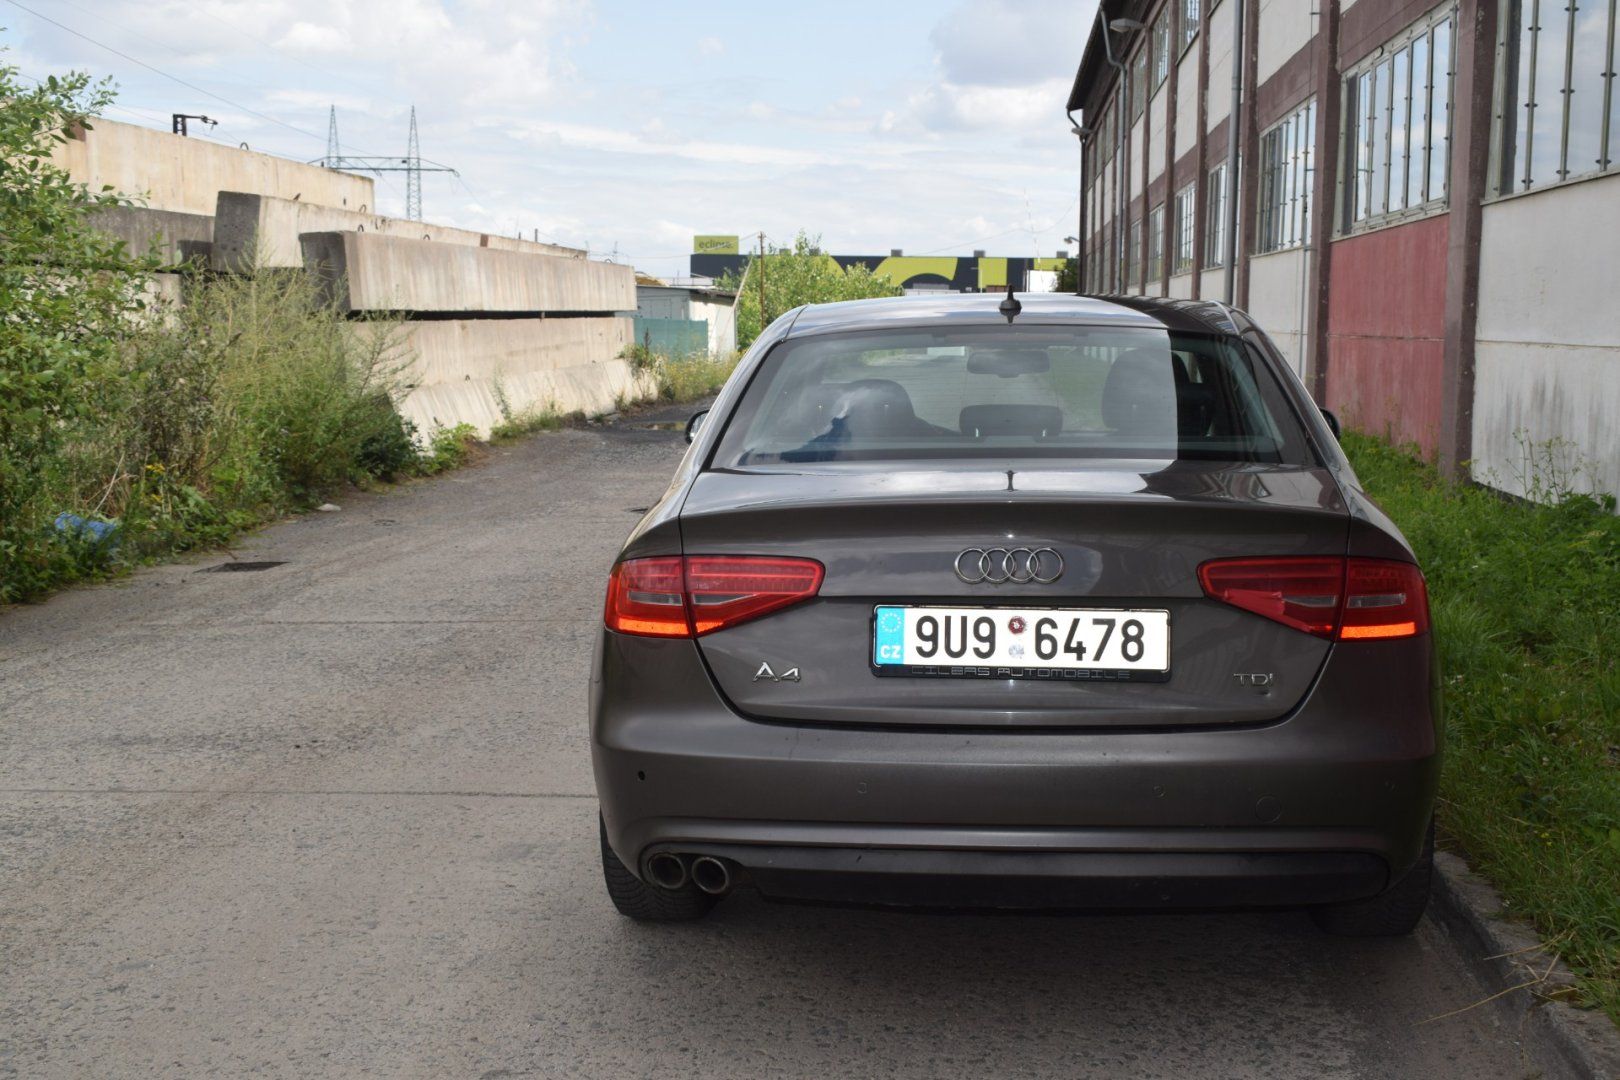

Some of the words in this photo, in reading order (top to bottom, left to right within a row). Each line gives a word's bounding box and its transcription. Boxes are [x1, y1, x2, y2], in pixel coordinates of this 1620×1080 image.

[915, 615, 996, 659] 9U9
[1034, 617, 1145, 662] 6478
[880, 644, 901, 659] CZ
[752, 661, 800, 682] A4
[1233, 672, 1274, 685] TDI
